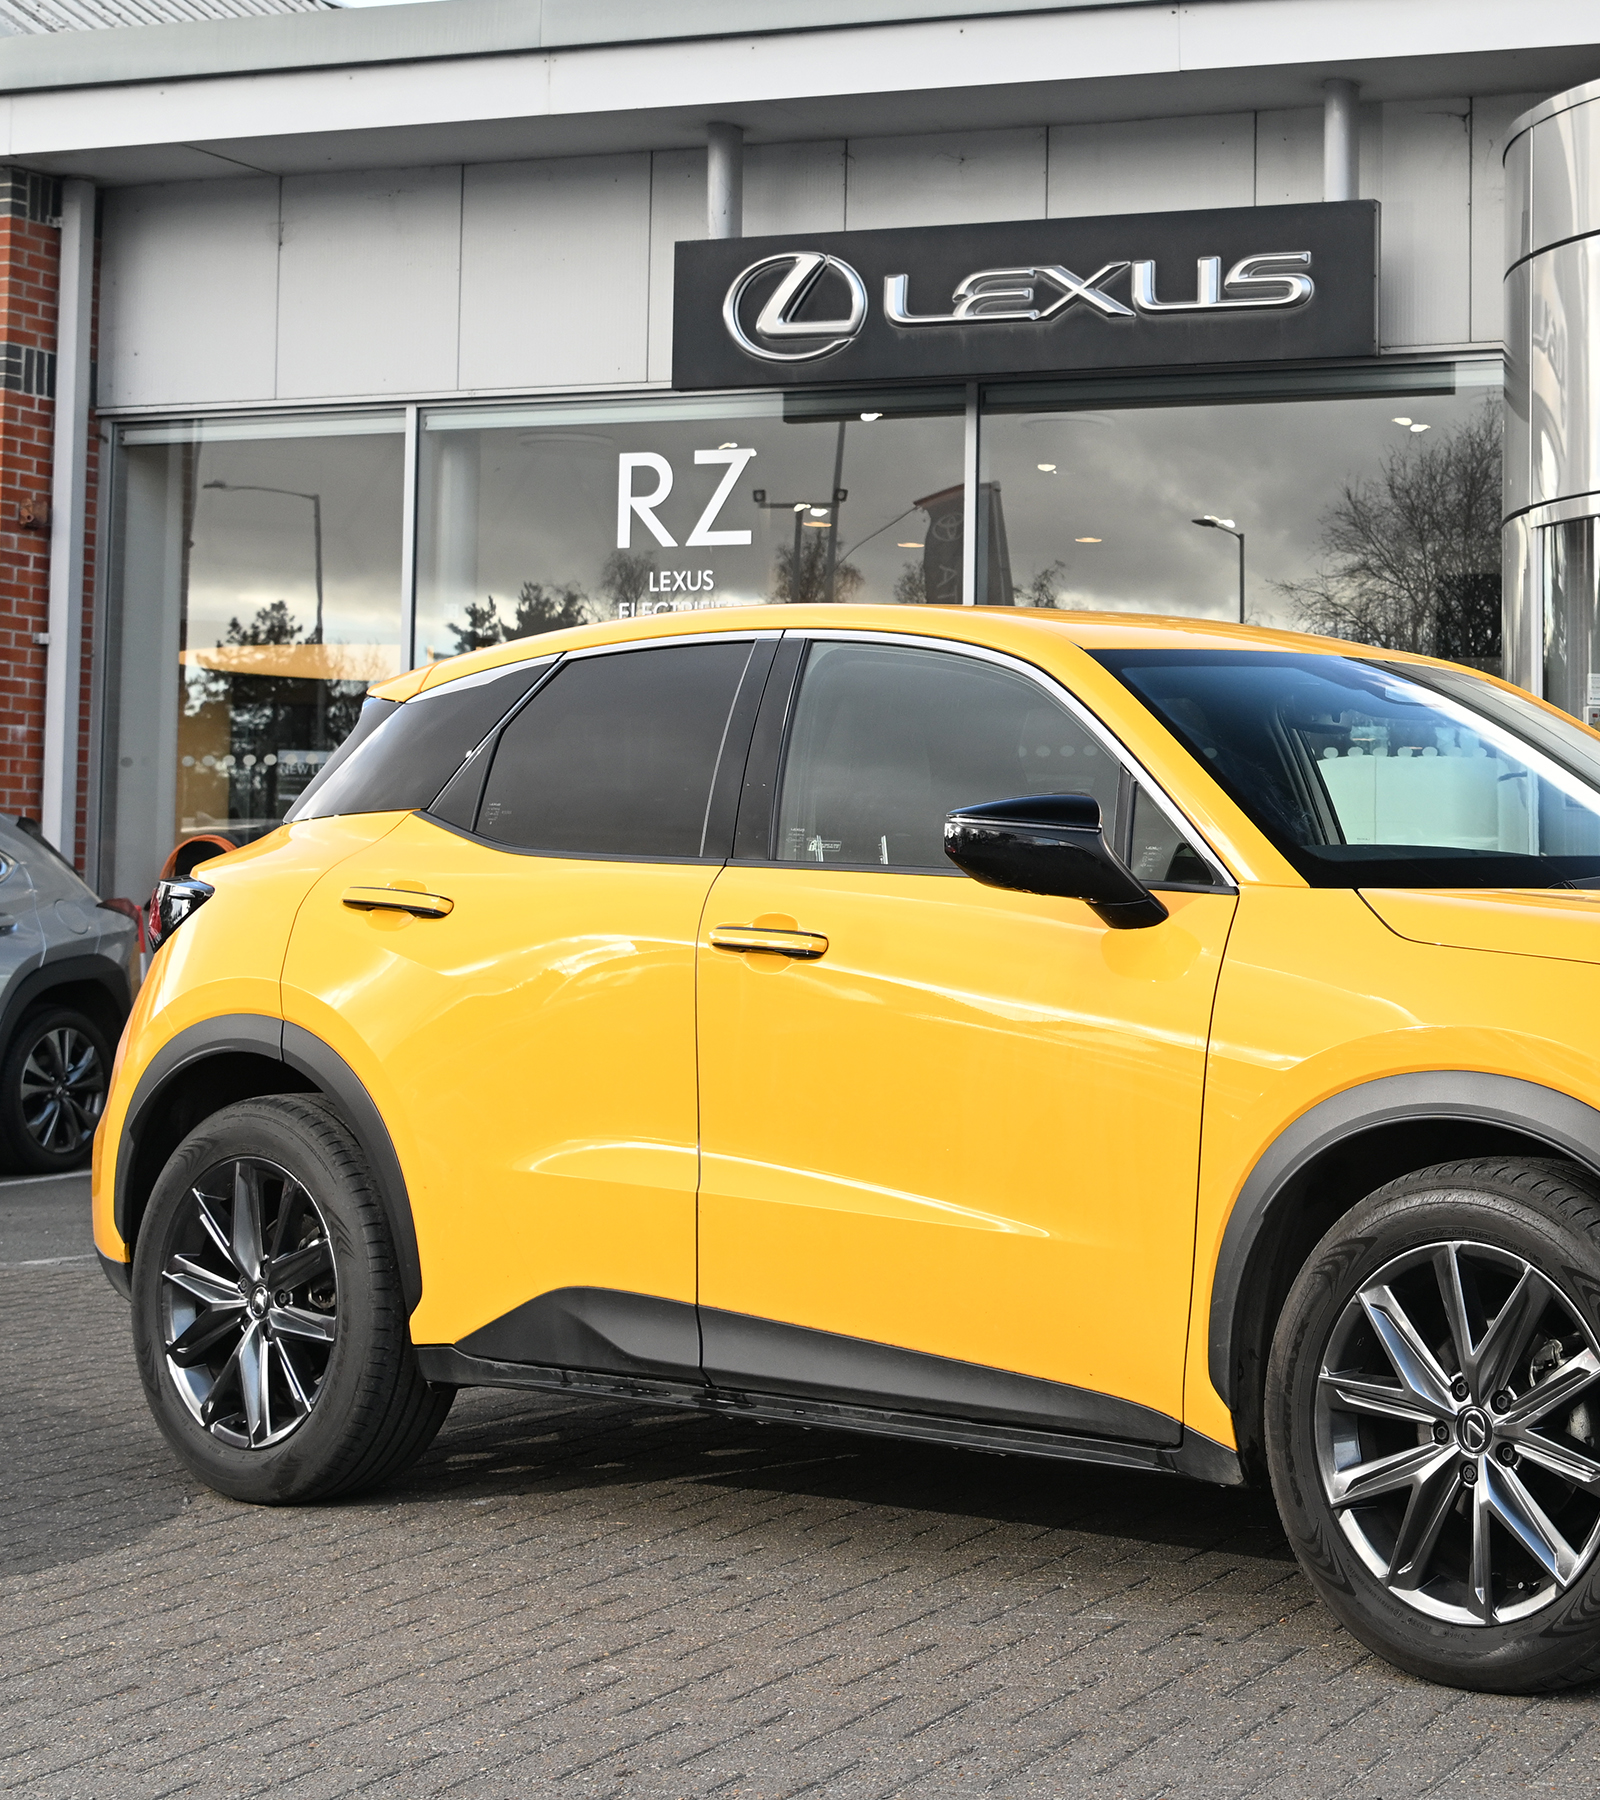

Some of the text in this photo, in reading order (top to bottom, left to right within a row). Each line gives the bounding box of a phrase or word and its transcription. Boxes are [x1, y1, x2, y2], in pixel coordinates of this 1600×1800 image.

[884, 251, 1316, 327] LEXUS
[617, 448, 753, 549] RZ
[649, 570, 714, 592] LEXUS
